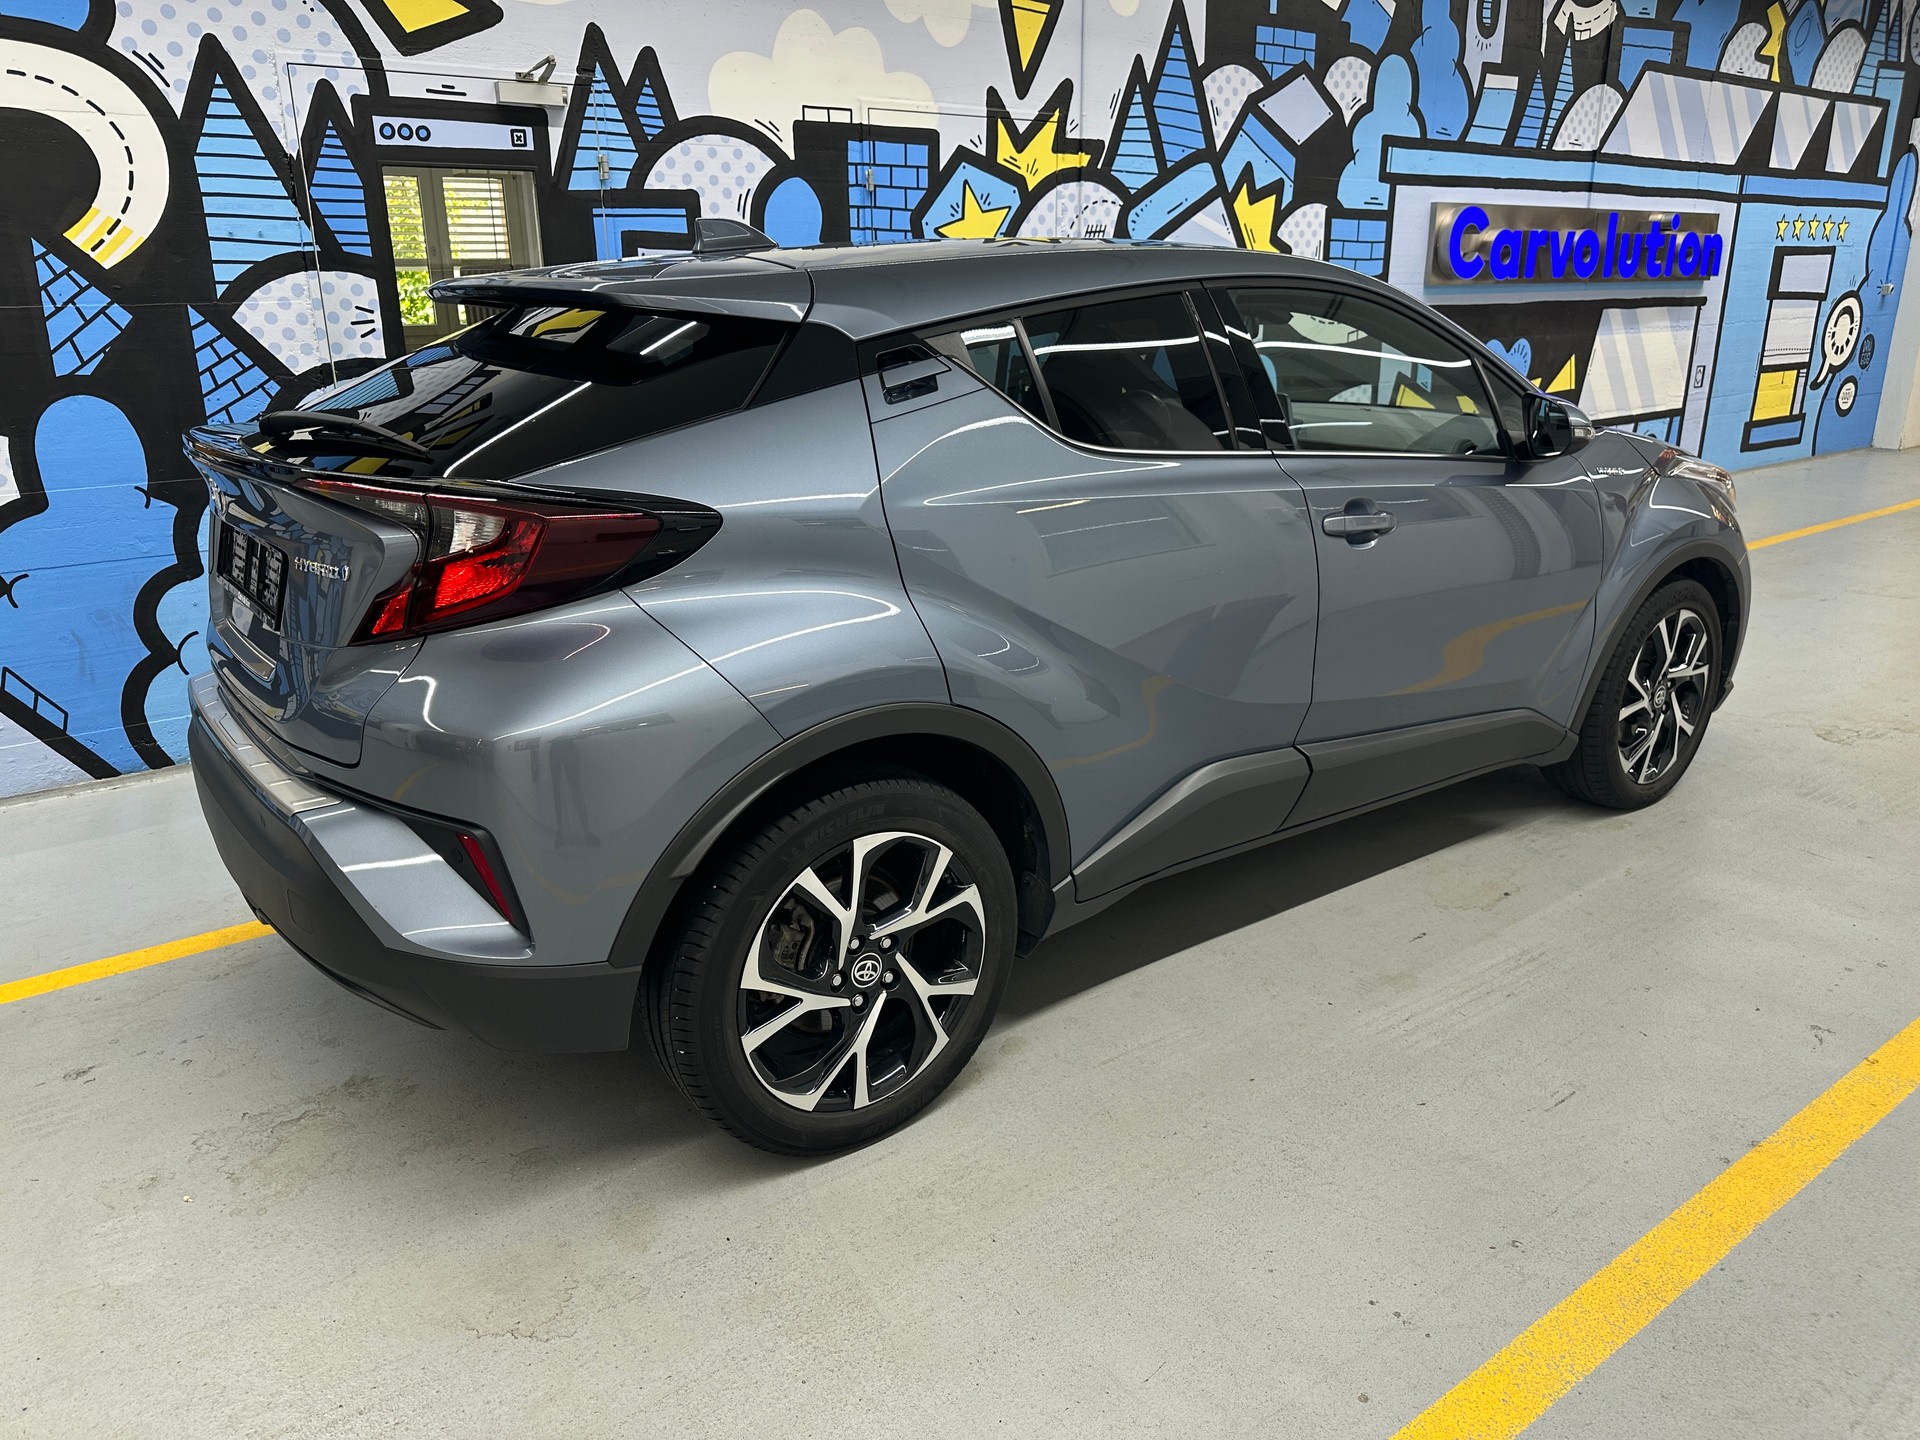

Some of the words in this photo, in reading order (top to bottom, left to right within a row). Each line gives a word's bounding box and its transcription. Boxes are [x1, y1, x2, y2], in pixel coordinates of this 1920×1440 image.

[1449, 206, 1723, 280] Carvolution
[294, 556, 340, 580] HYBRID
[803, 804, 885, 848] MICHELIN
